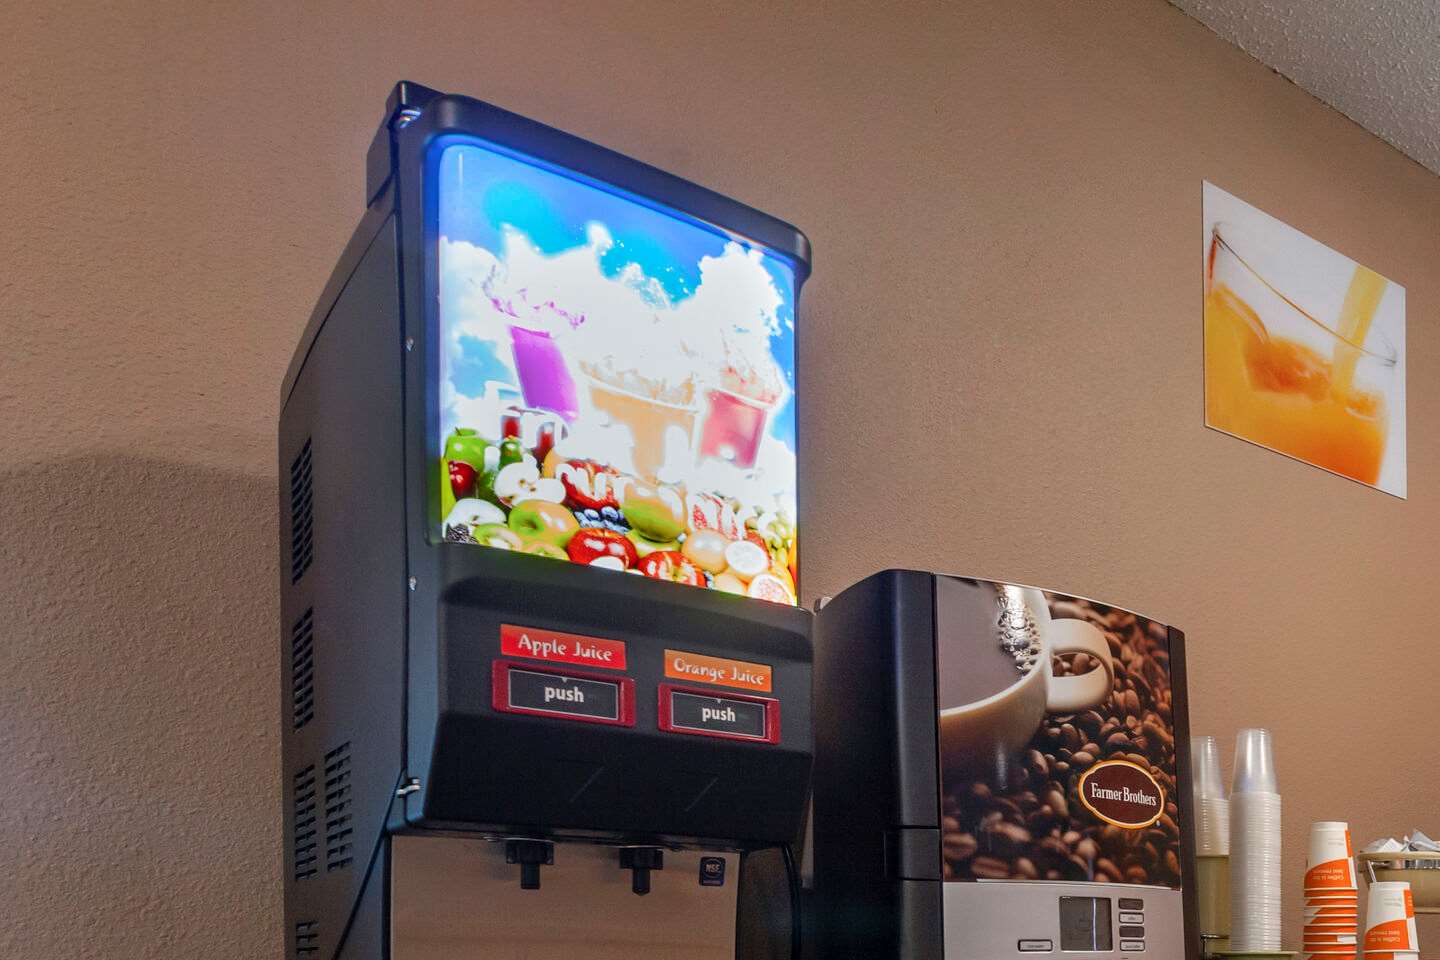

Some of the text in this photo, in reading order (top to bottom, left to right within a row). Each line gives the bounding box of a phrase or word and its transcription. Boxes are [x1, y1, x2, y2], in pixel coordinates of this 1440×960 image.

[518, 633, 615, 662] Apple Juice
[673, 657, 766, 686] Orange Juice
[544, 685, 585, 703] push
[702, 706, 736, 722] push
[1090, 782, 1156, 806] Farmer Brothers
